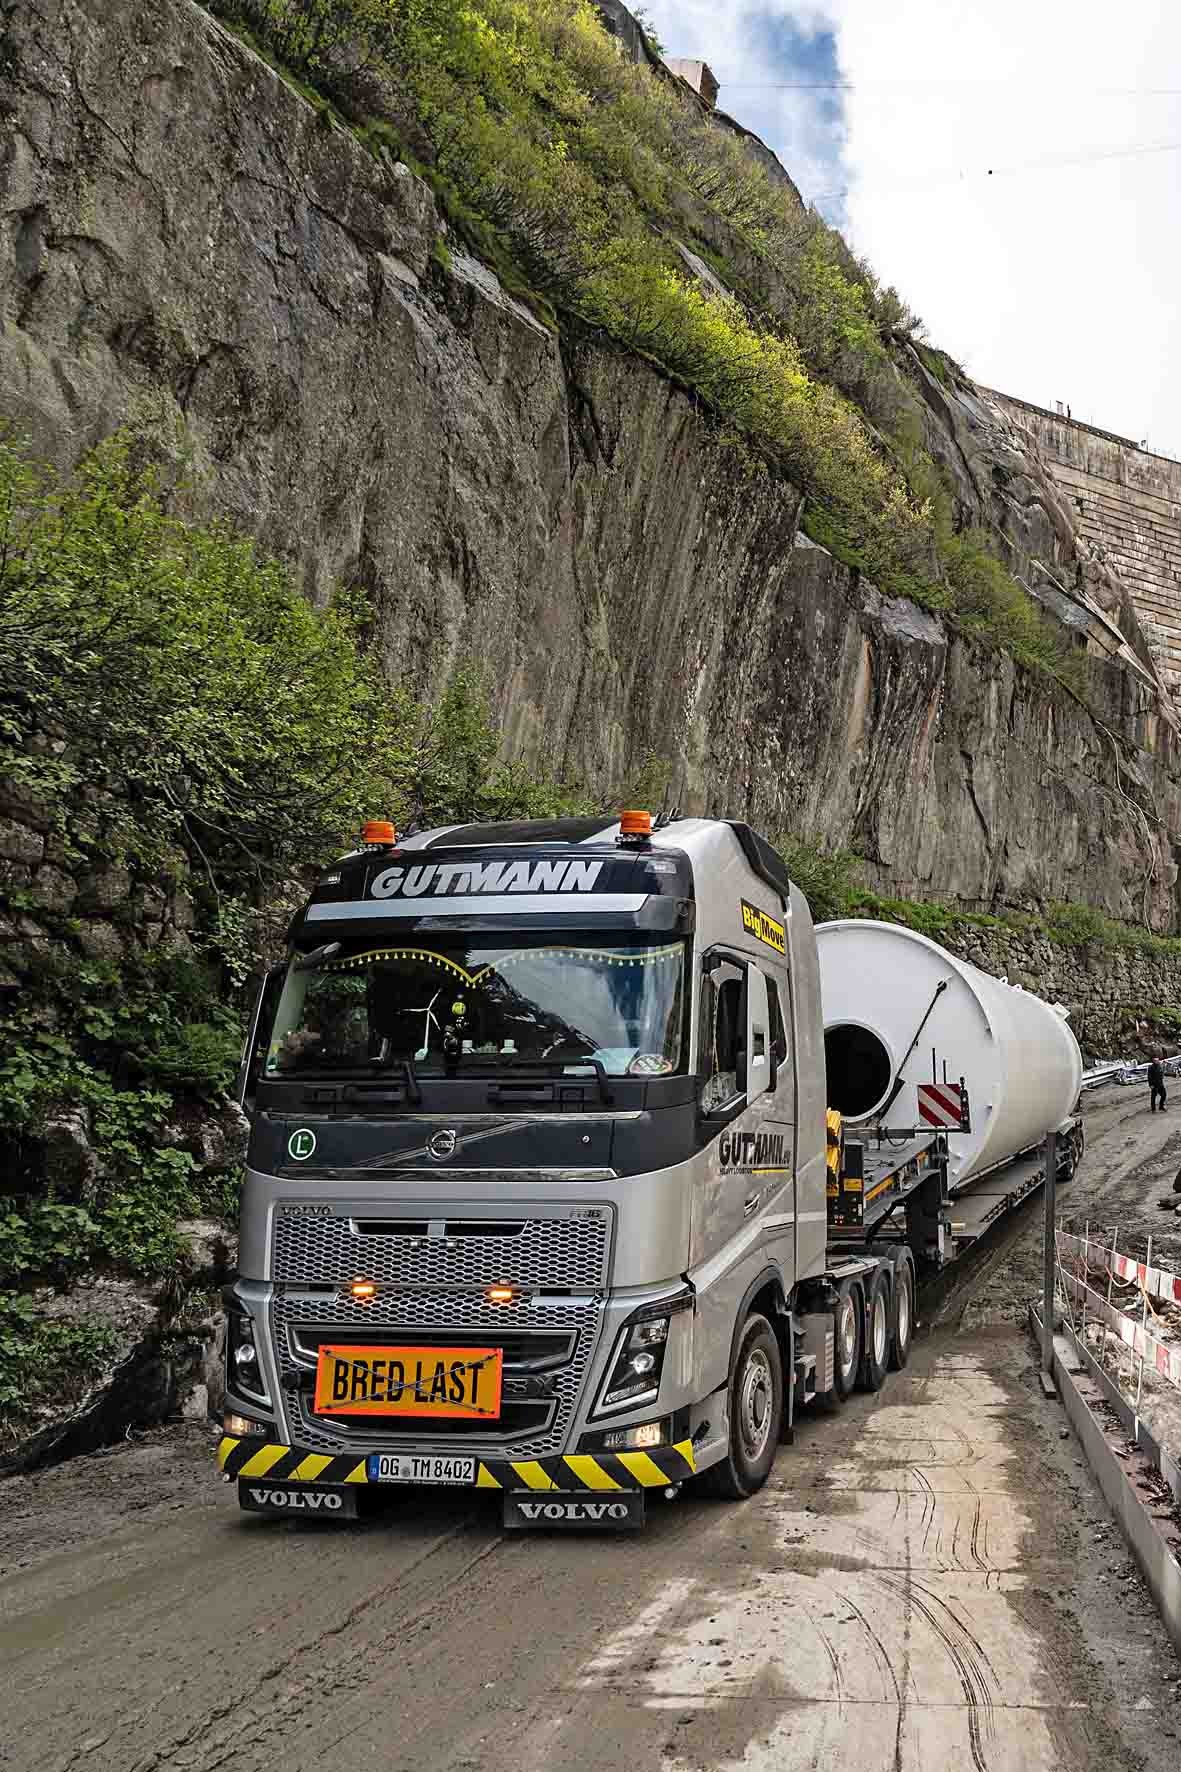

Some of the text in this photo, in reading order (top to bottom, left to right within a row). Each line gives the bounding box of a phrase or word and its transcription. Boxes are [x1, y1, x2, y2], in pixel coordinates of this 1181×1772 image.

[370, 861, 604, 898] GUTMANN
[280, 1206, 333, 1216] VOLVO
[332, 1359, 485, 1404] BRED LAST
[380, 1457, 472, 1480] OG TM 8402
[248, 1488, 343, 1509] VOLVO
[517, 1503, 629, 1519] VOLVO
